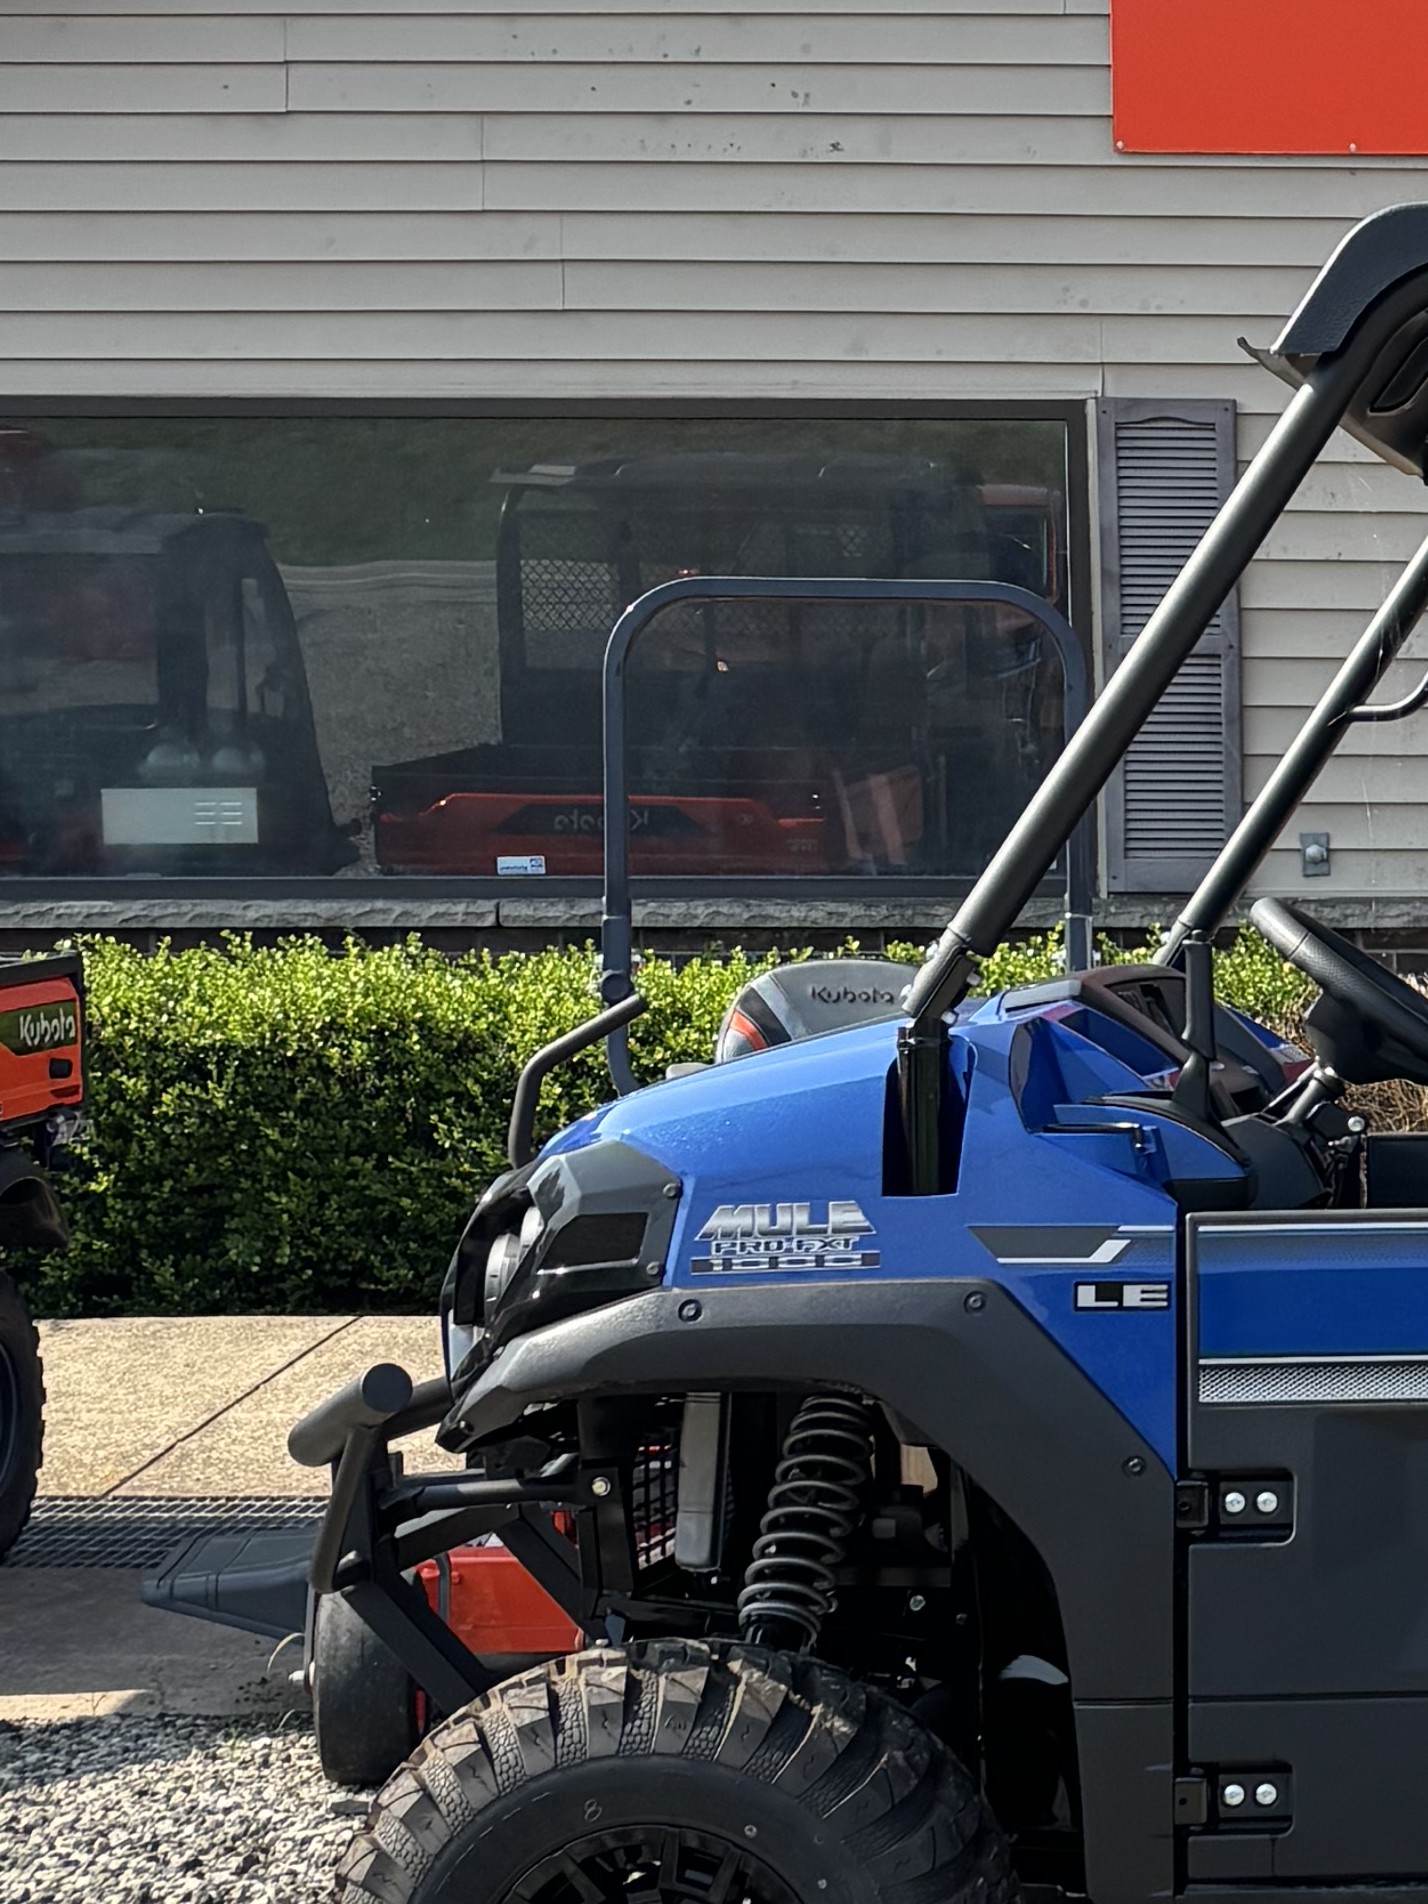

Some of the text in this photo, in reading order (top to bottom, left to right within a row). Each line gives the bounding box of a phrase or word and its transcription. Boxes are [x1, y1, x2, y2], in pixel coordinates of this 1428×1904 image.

[811, 986, 895, 1005] Kubota
[19, 1007, 76, 1047] Kubota
[694, 1200, 877, 1241] MULE
[1077, 1284, 1169, 1309] LE
